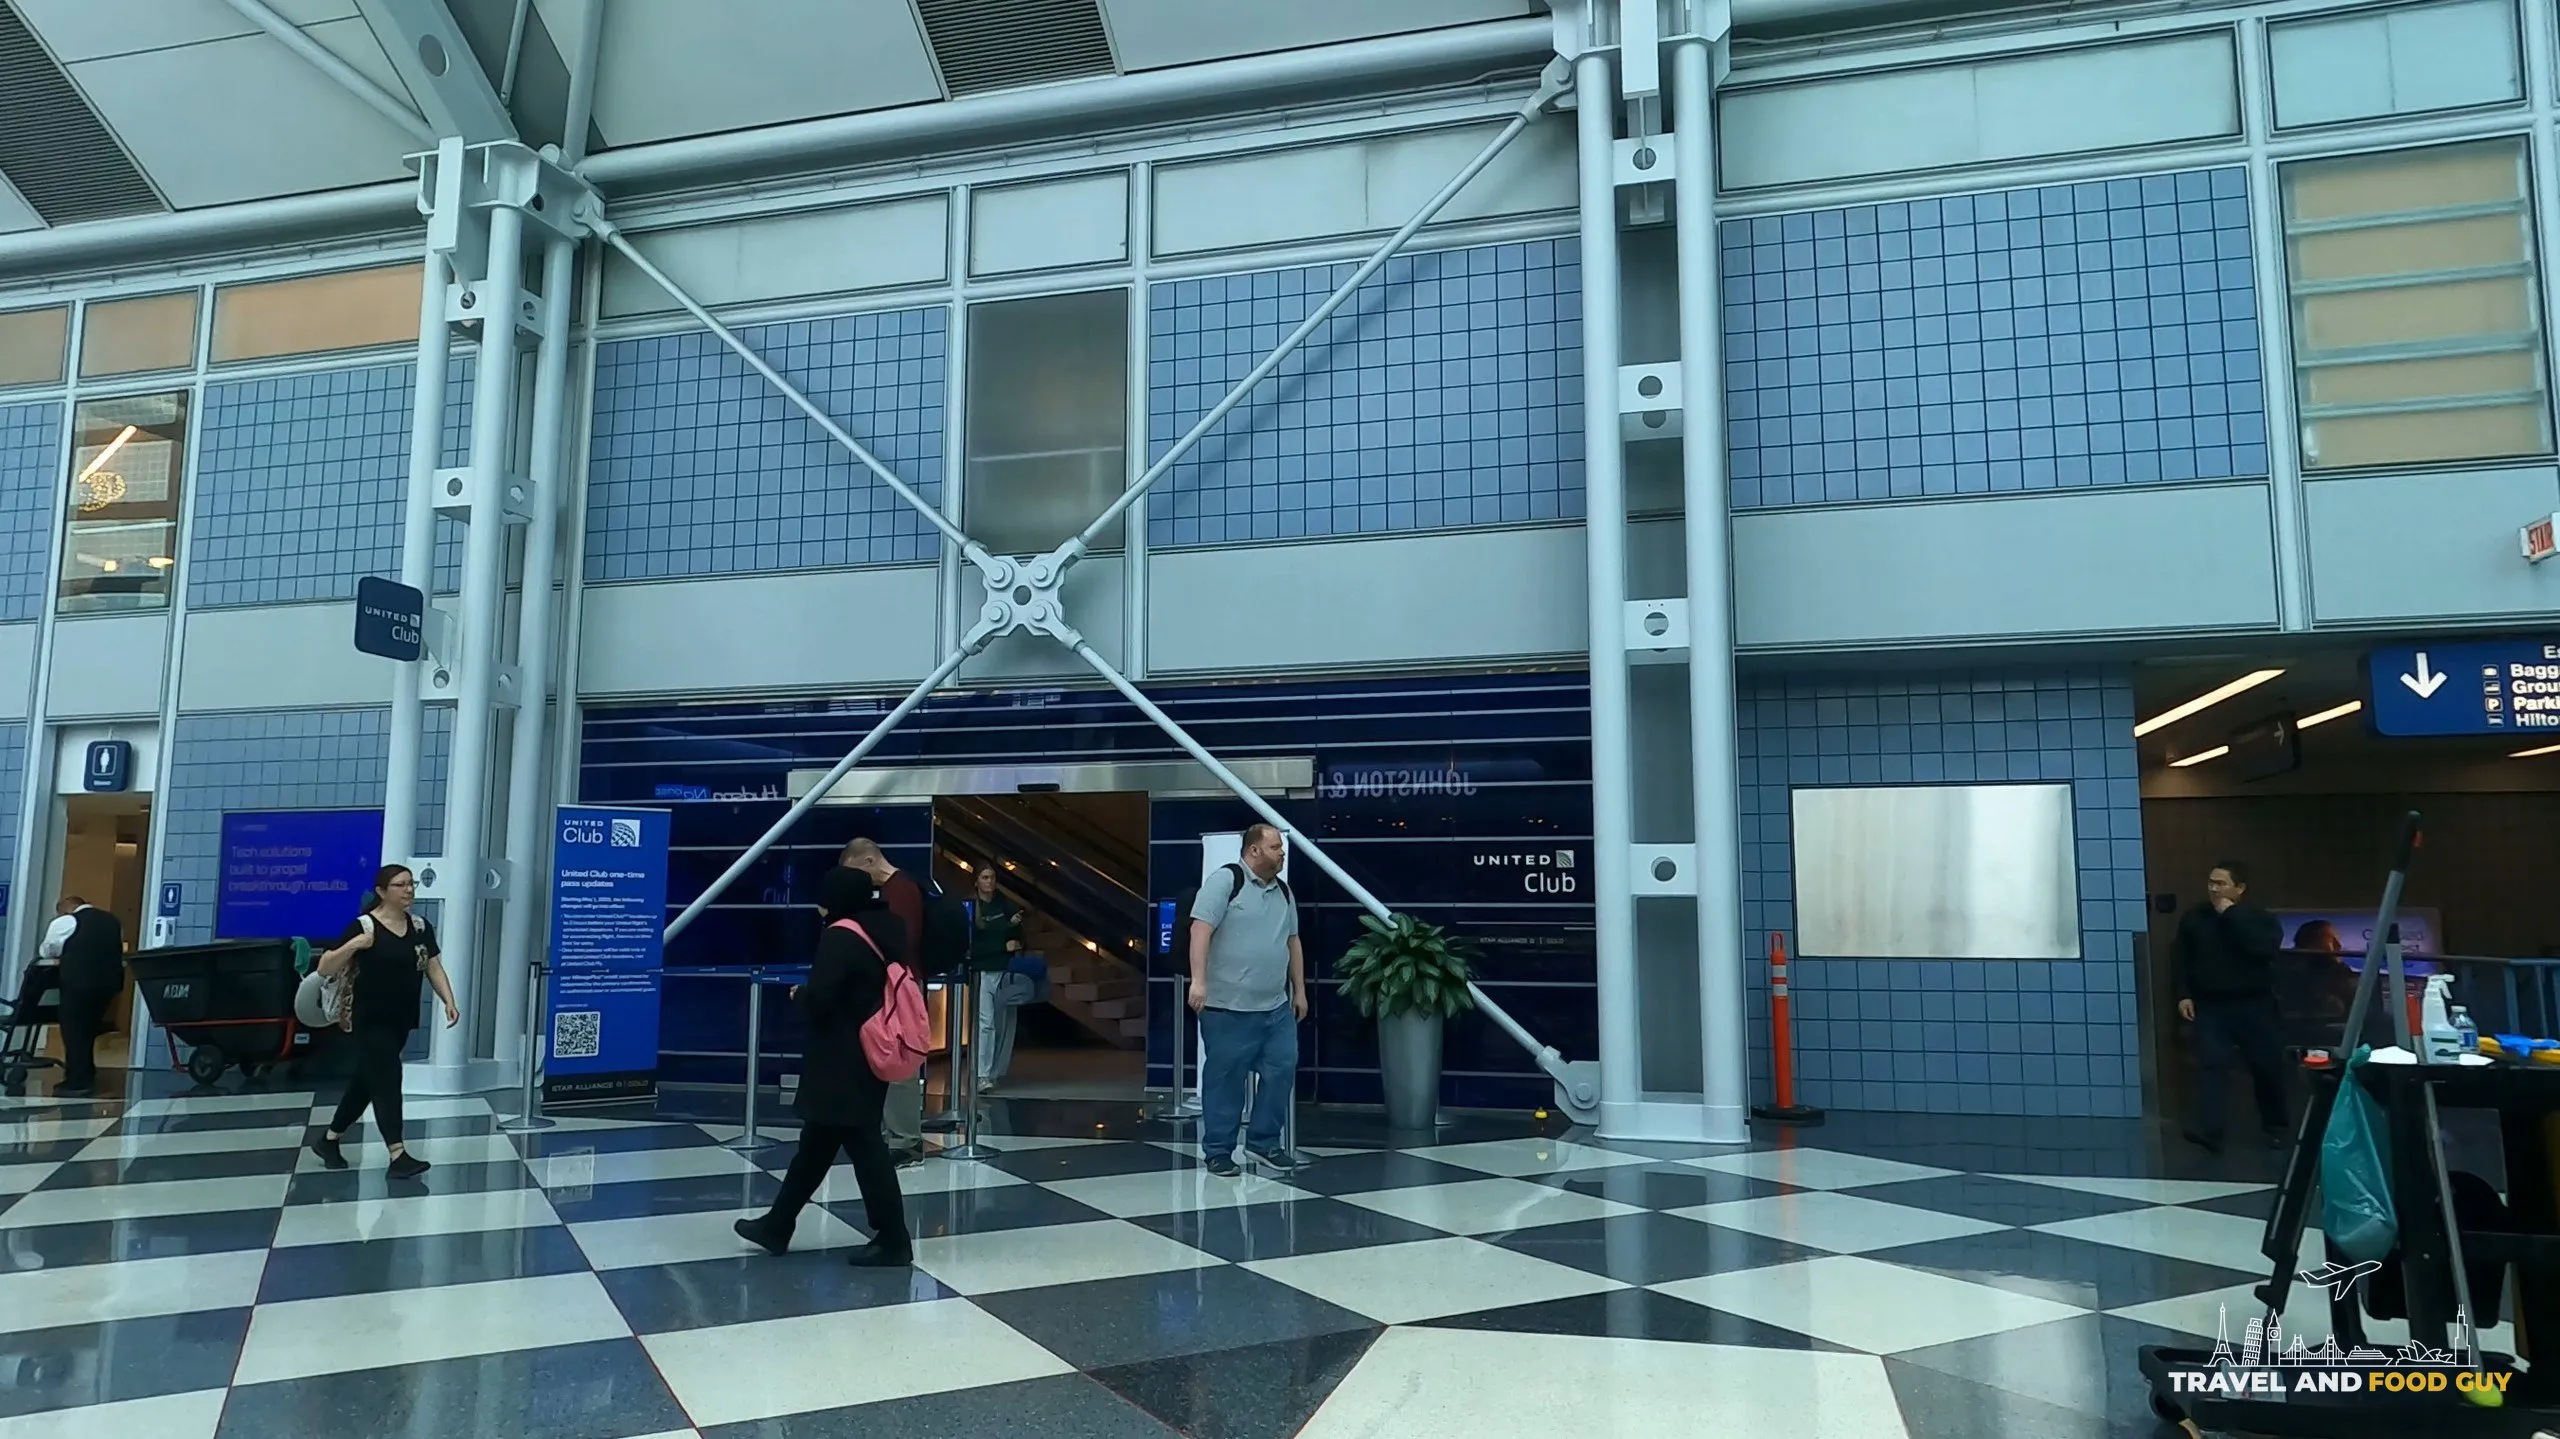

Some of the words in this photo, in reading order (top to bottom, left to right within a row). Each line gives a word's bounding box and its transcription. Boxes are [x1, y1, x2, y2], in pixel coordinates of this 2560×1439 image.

[365, 605, 408, 622] UNITED
[392, 625, 419, 644] Club
[2510, 664, 2560, 680] Bagg
[2512, 680, 2560, 694] Grou
[2516, 713, 2560, 727] Hilto
[564, 819, 604, 827] UNITED
[563, 827, 603, 844] Club
[1473, 855, 1551, 865] UNITED
[561, 869, 588, 877] United
[589, 870, 608, 878] Club
[560, 880, 580, 888] pass
[581, 880, 614, 888] updates
[1524, 872, 1576, 893] Club
